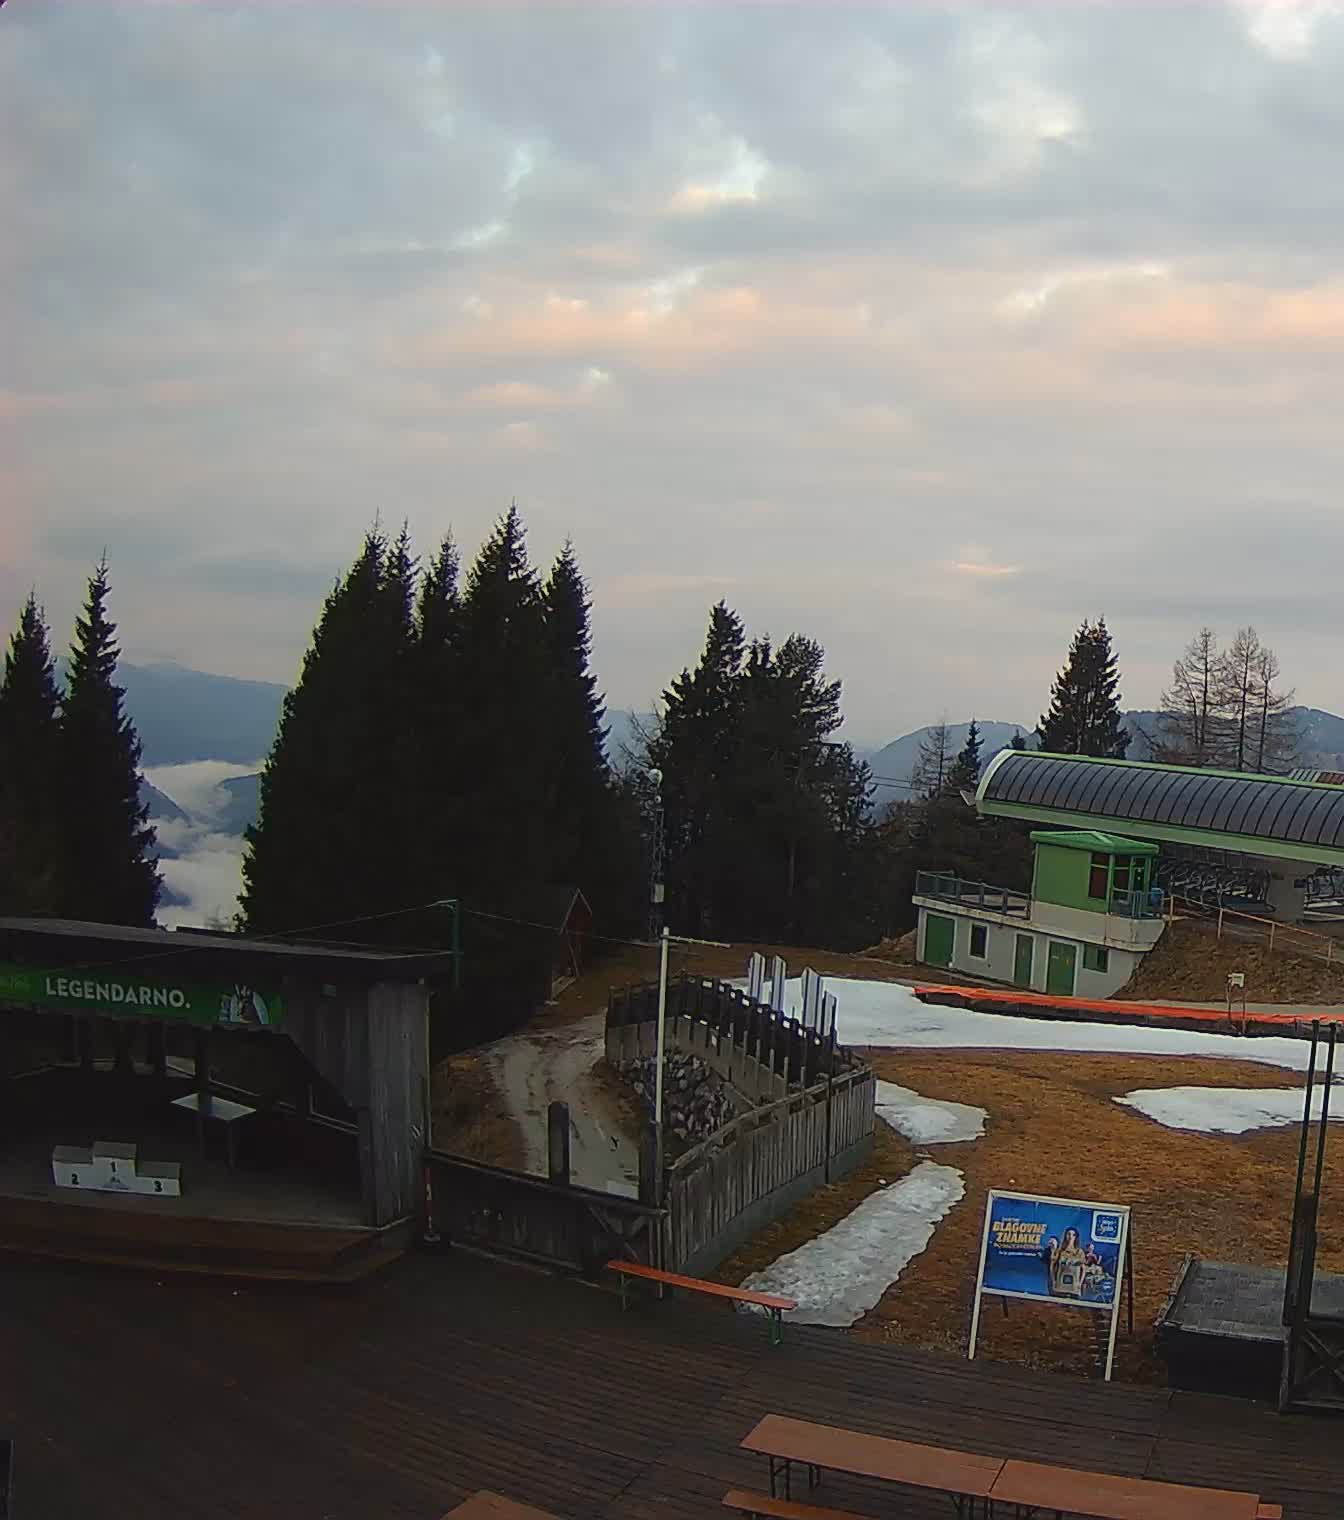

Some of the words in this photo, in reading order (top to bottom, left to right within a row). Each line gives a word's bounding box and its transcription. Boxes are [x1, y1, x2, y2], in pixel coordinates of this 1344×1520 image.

[45, 975, 192, 1010] LEGENDARNO.
[110, 1161, 116, 1172] 1
[72, 1173, 79, 1185] 2
[154, 1180, 162, 1192] 3
[992, 1220, 1048, 1235] BLAGOVNE
[996, 1232, 1042, 1245] ZNAMKE
